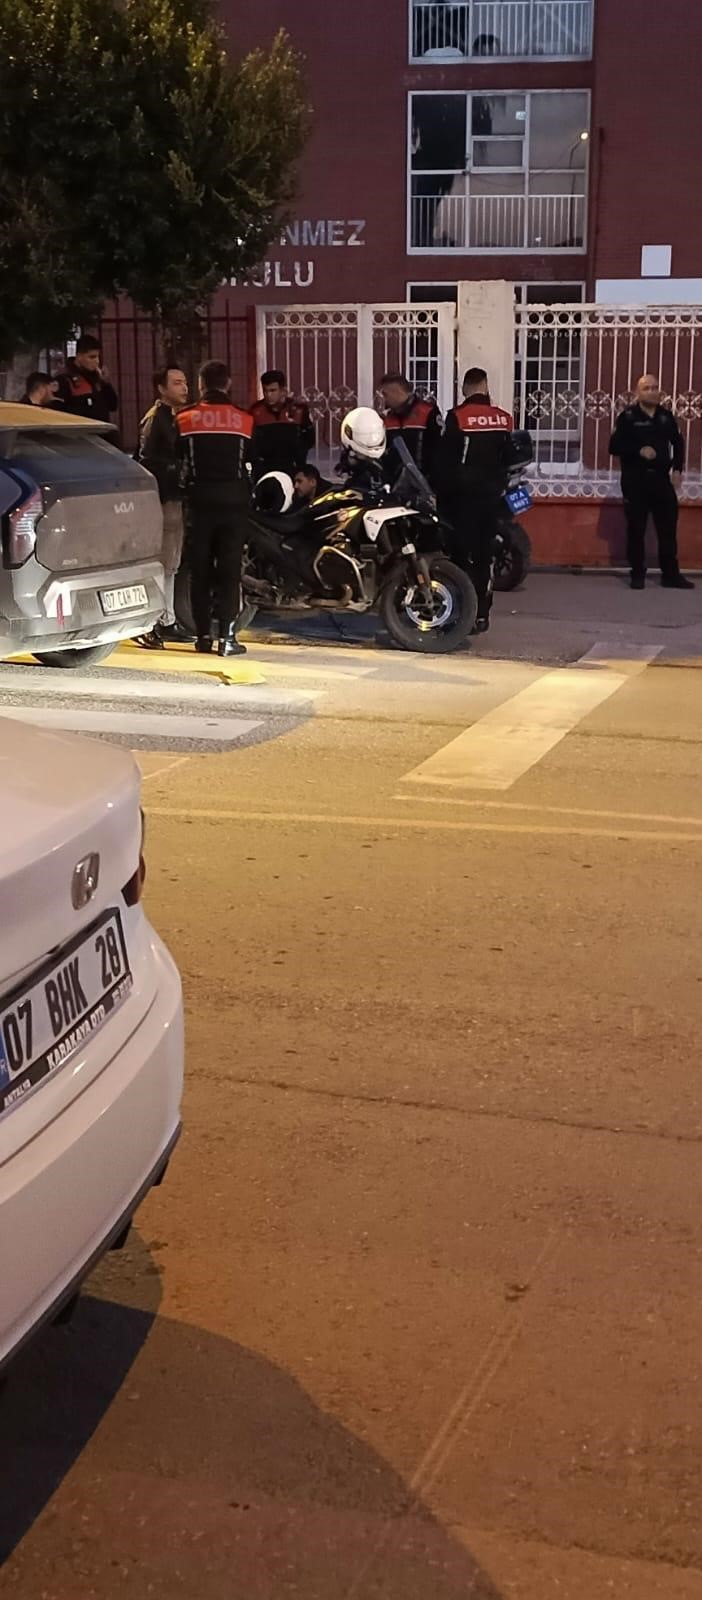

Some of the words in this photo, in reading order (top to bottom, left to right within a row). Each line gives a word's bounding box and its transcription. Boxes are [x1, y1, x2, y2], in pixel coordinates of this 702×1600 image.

[262, 220, 366, 246] NMEZ
[219, 261, 314, 287] ULU
[467, 415, 509, 427] POLİS
[105, 592, 115, 608] 07
[2, 998, 33, 1072] 07
[45, 957, 88, 1036] BHK
[95, 926, 120, 988] 28
[46, 1019, 91, 1069] KARAKAYA
